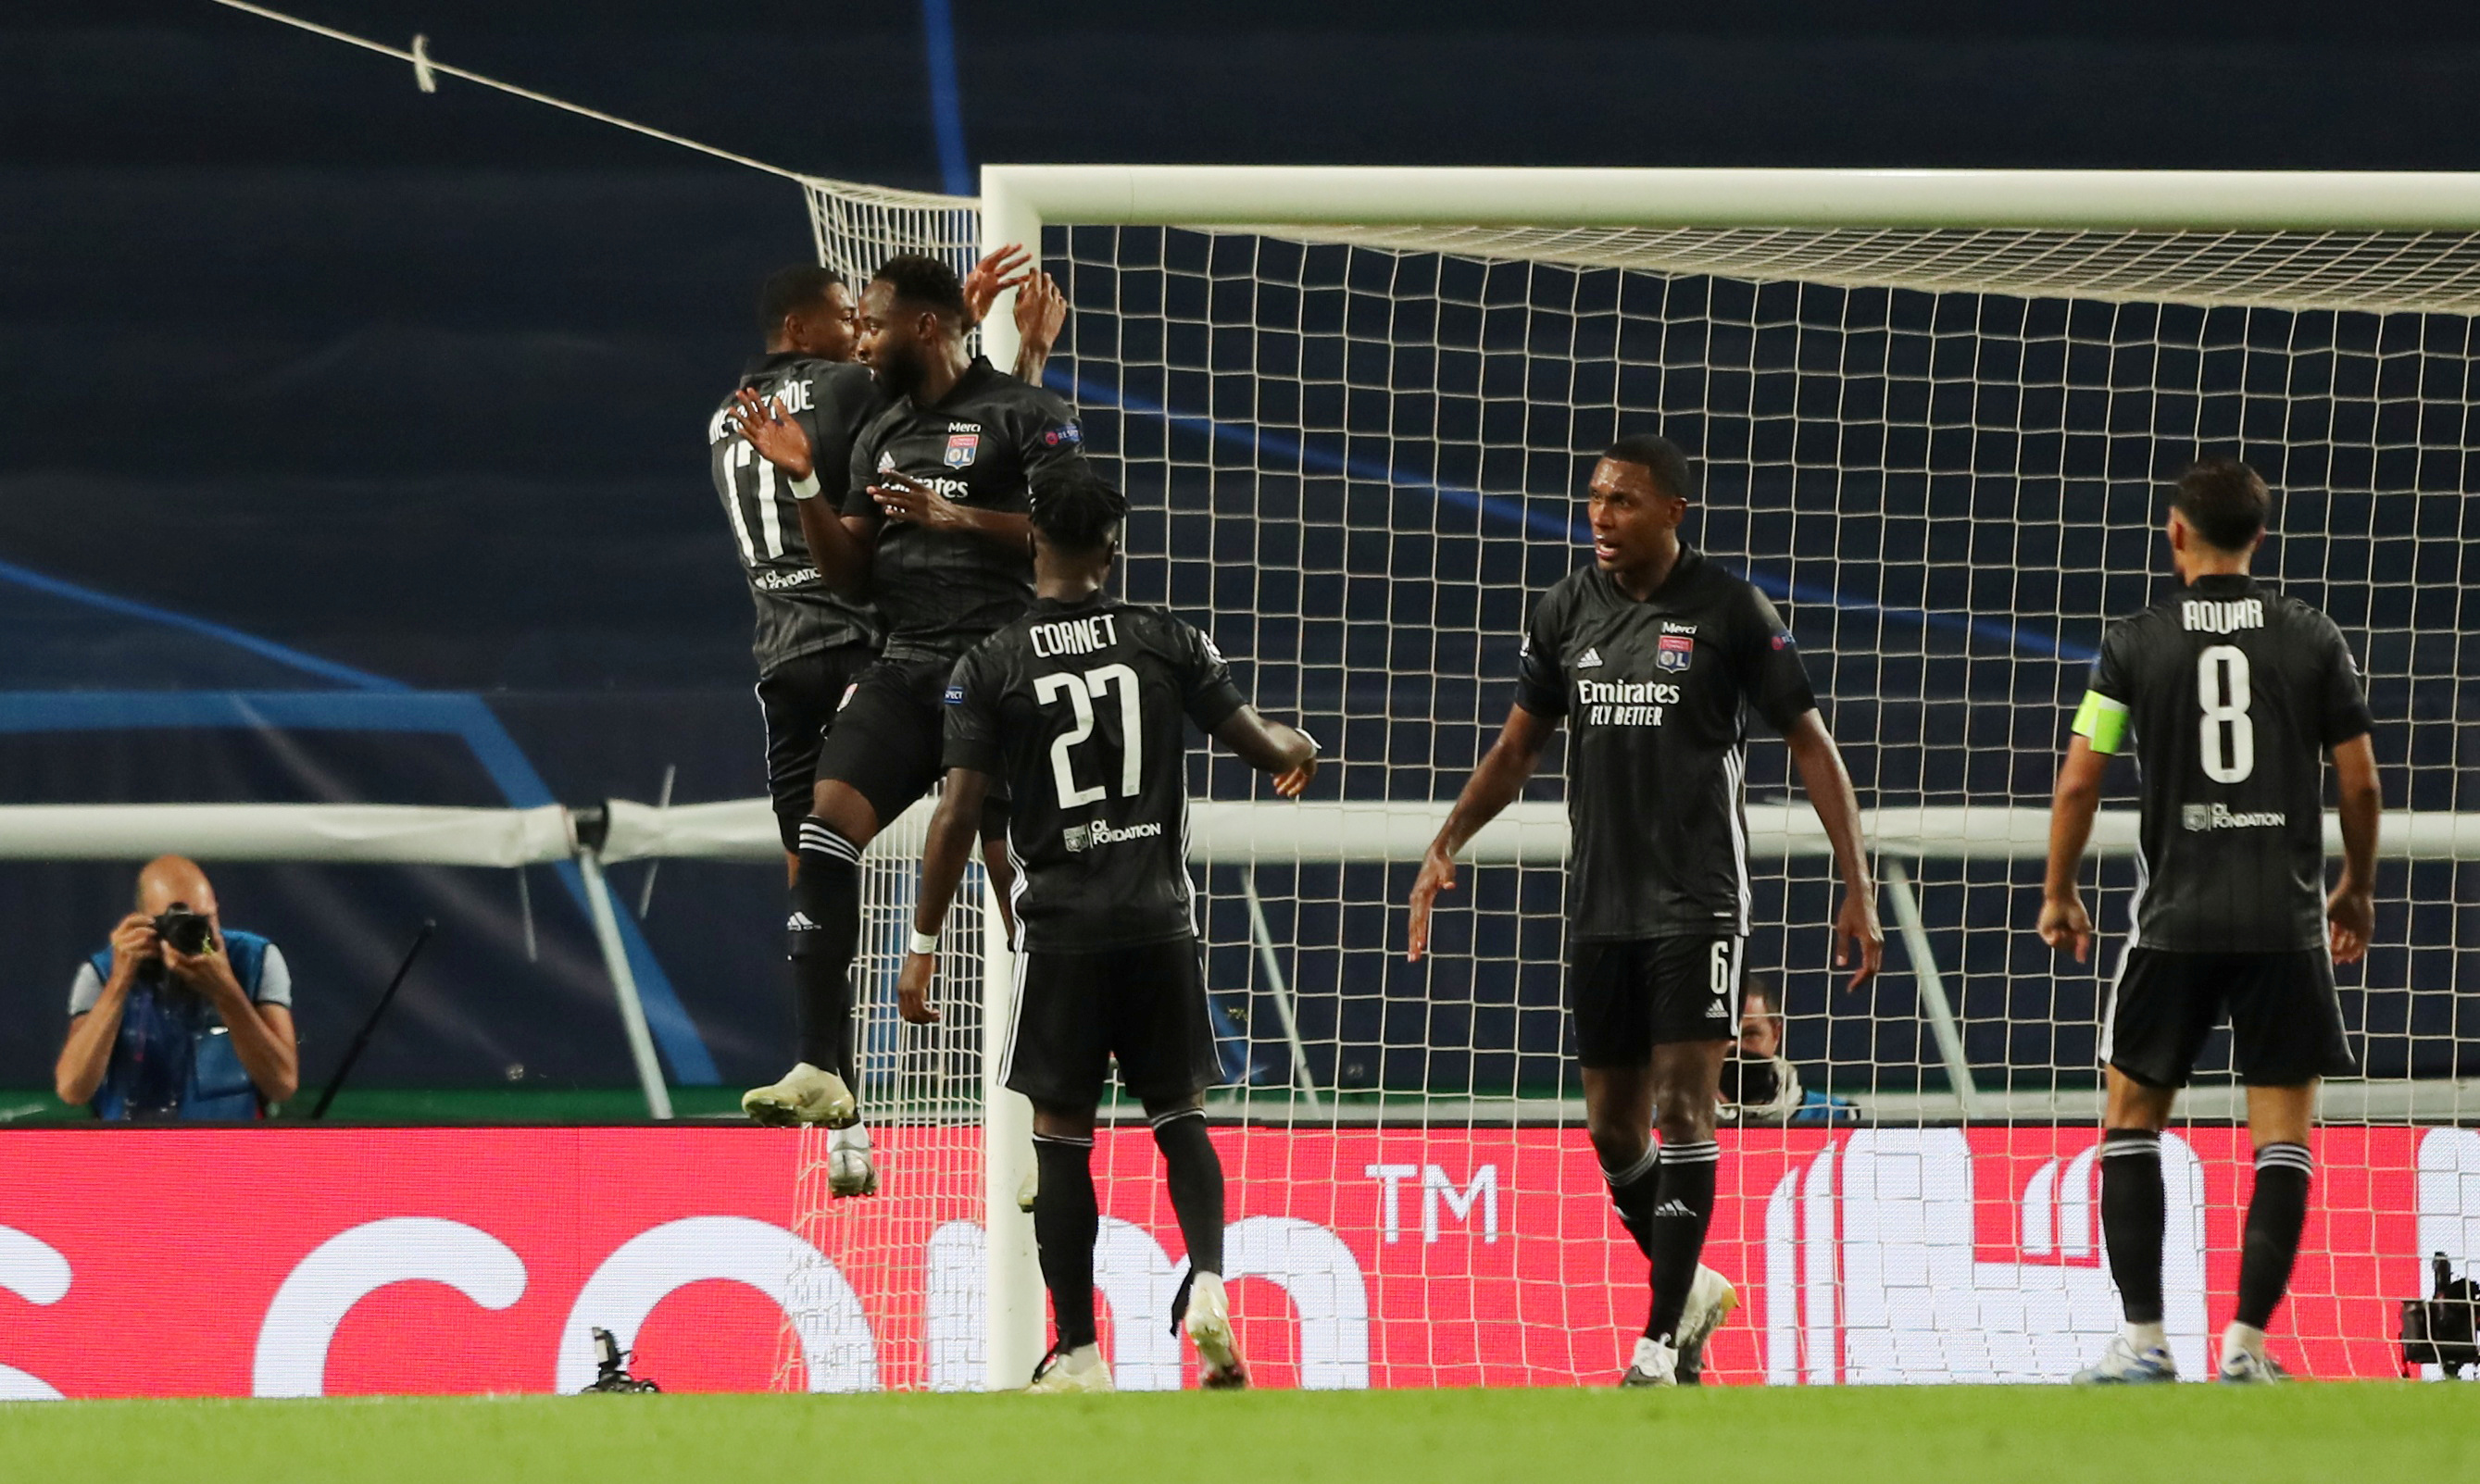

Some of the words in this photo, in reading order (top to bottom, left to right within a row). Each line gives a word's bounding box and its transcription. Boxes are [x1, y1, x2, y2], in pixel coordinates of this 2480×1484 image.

[948, 422, 982, 433] Merci
[1661, 621, 1697, 634] Merci
[2182, 597, 2264, 634] AOUAR
[1029, 615, 1118, 657] CORNET
[1577, 679, 1680, 705] Emirates
[1590, 705, 1612, 726] FLY
[1614, 705, 1663, 726] BETTER
[2198, 644, 2254, 784] 8
[1033, 663, 1143, 810] 27
[1091, 819, 1109, 833] OL
[1093, 822, 1161, 845] FONDATION
[2211, 813, 2286, 829] FONDATION
[1710, 941, 1730, 995] 6
[1365, 1164, 1498, 1242] TM
